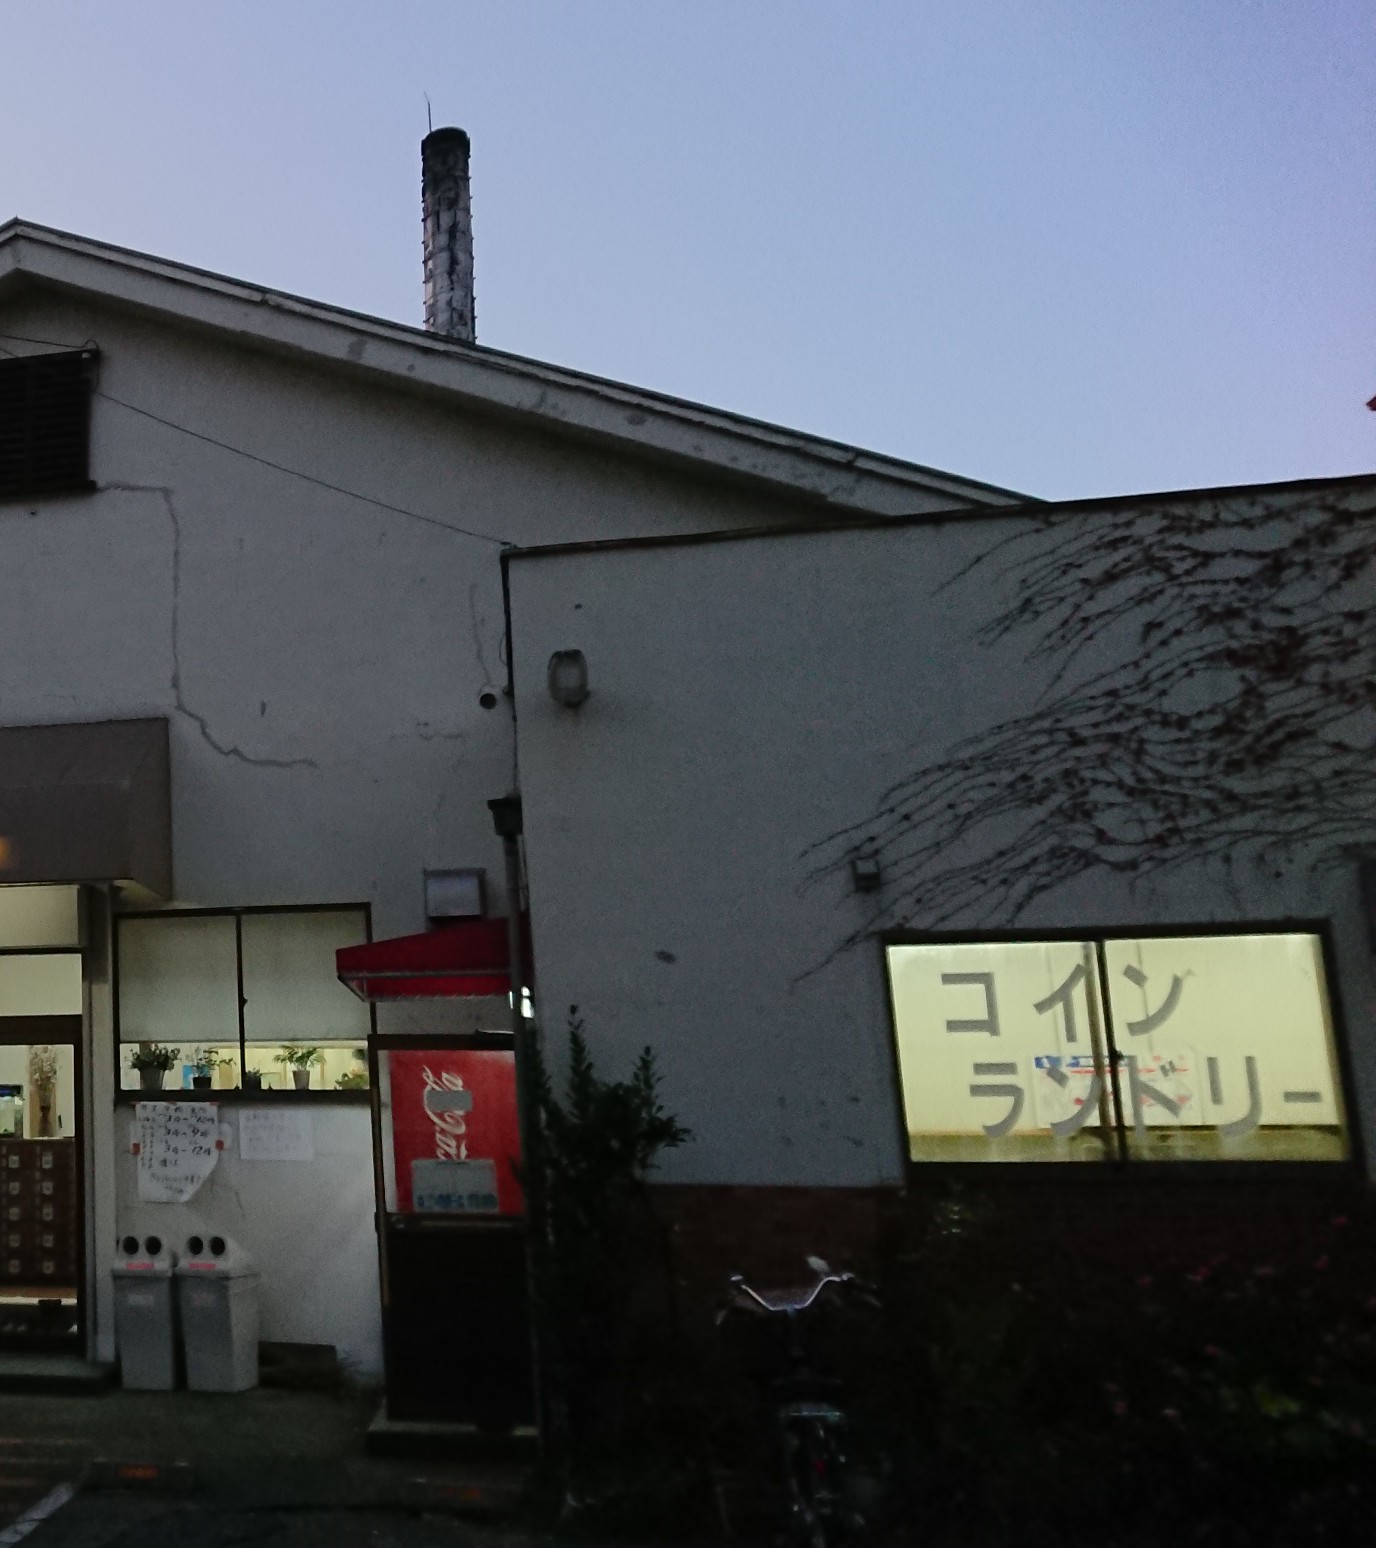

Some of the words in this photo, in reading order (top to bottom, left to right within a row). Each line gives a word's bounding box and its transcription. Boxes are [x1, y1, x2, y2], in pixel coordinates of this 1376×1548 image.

[940, 963, 1186, 1043] コイン
[969, 1055, 1322, 1139] ランドリー
